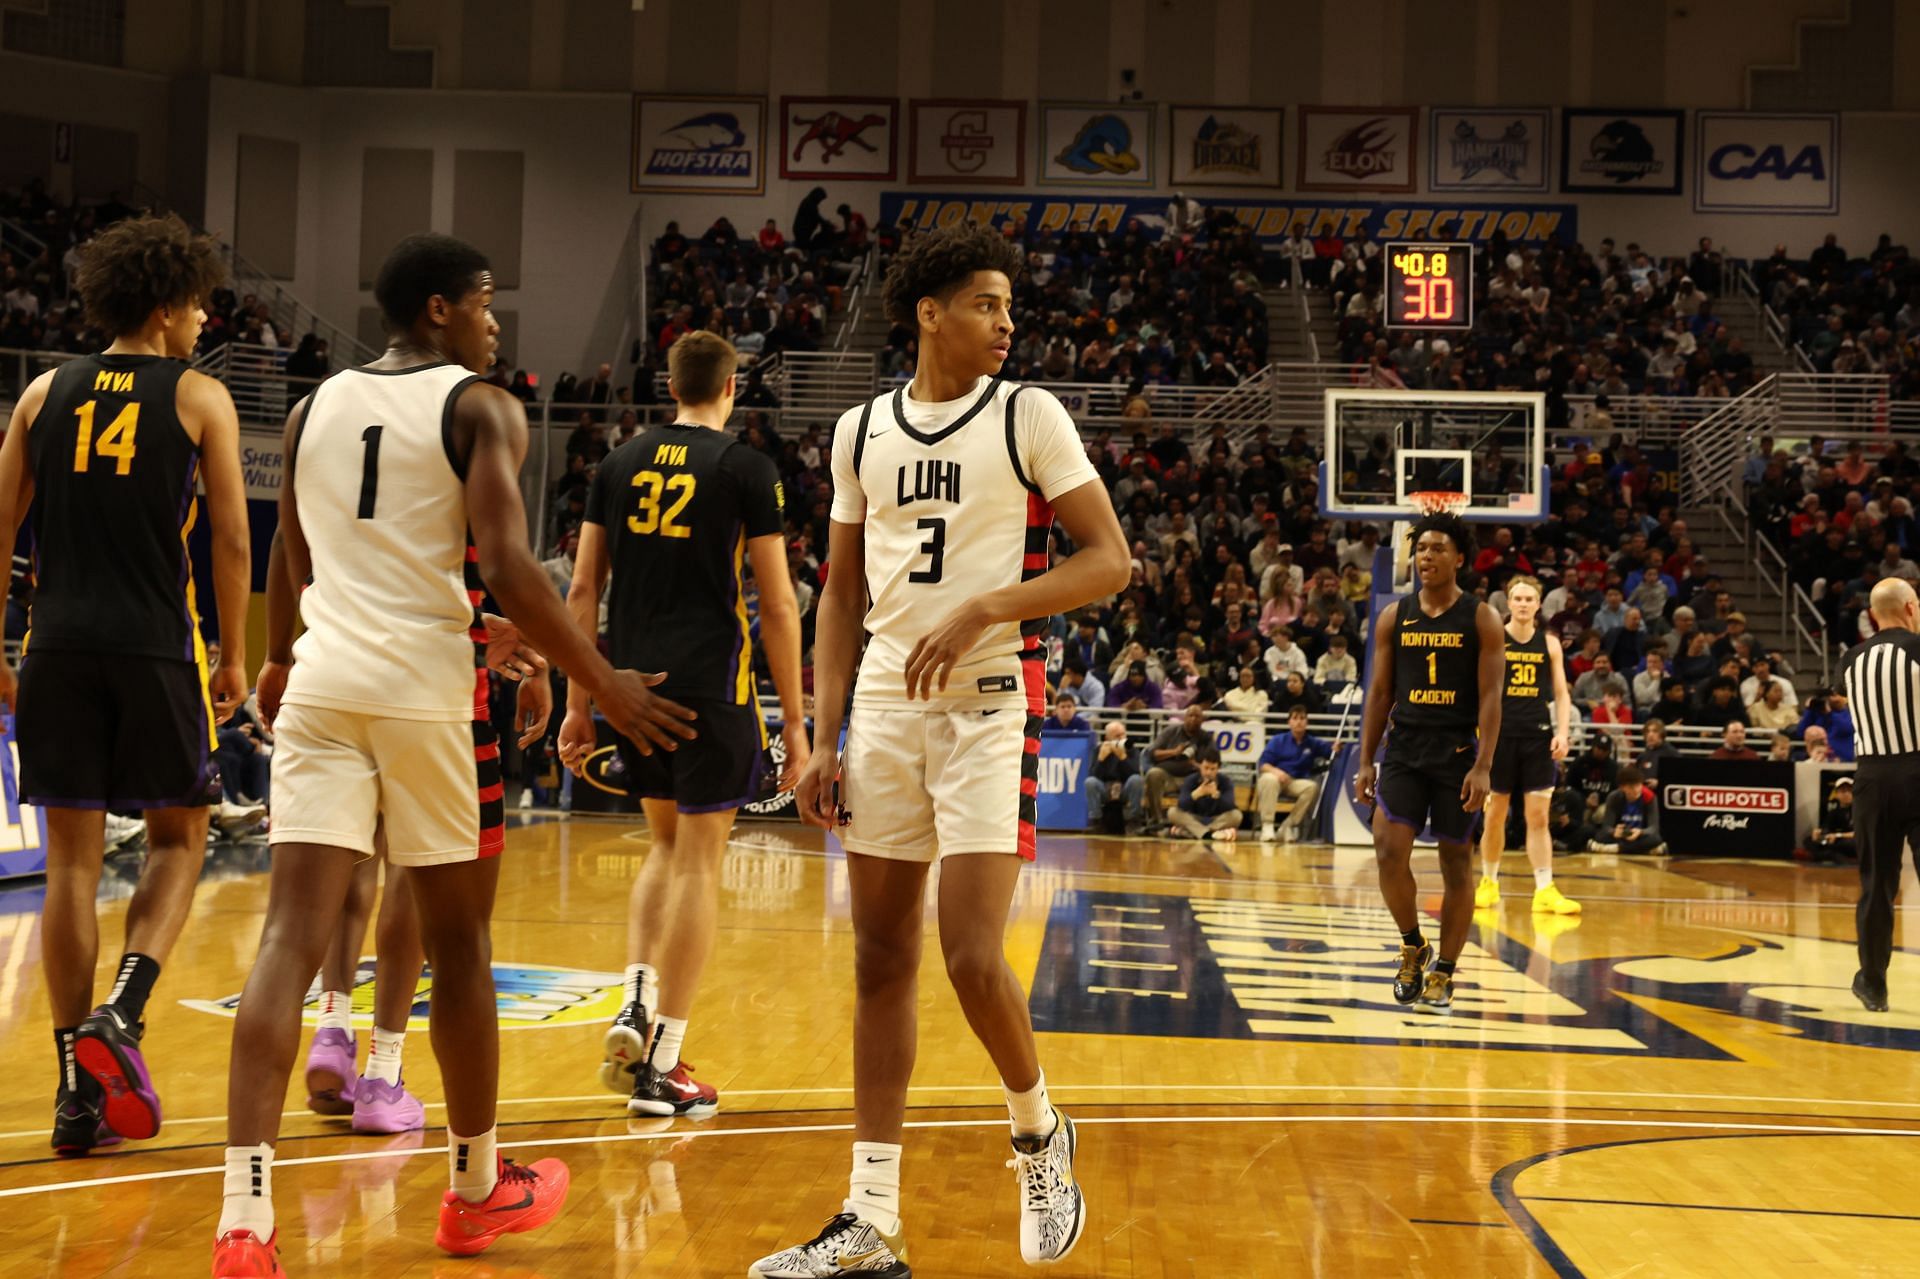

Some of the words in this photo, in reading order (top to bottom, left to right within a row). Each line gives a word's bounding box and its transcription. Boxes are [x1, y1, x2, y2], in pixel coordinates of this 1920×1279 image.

[652, 151, 749, 169] HOFSTRA
[1328, 151, 1394, 171] ELON
[1708, 143, 1825, 180] CAA
[1037, 203, 1127, 232] DEN
[1376, 209, 1563, 241] SECTION
[1394, 253, 1447, 277] 40.8
[1404, 278, 1453, 319] 30
[94, 370, 135, 392] MVA
[73, 399, 141, 475] 14
[653, 443, 688, 467] MVA
[357, 425, 384, 519] 1
[897, 459, 961, 508] LUHI
[626, 469, 697, 539] 32
[908, 517, 946, 584] 3
[1400, 631, 1464, 648] MONTVERDE
[1425, 651, 1437, 685] 1
[1510, 663, 1537, 686] 30
[1408, 688, 1457, 705] ACADEMY
[1205, 731, 1252, 752] 06
[1691, 790, 1783, 808] CHIPOTLE
